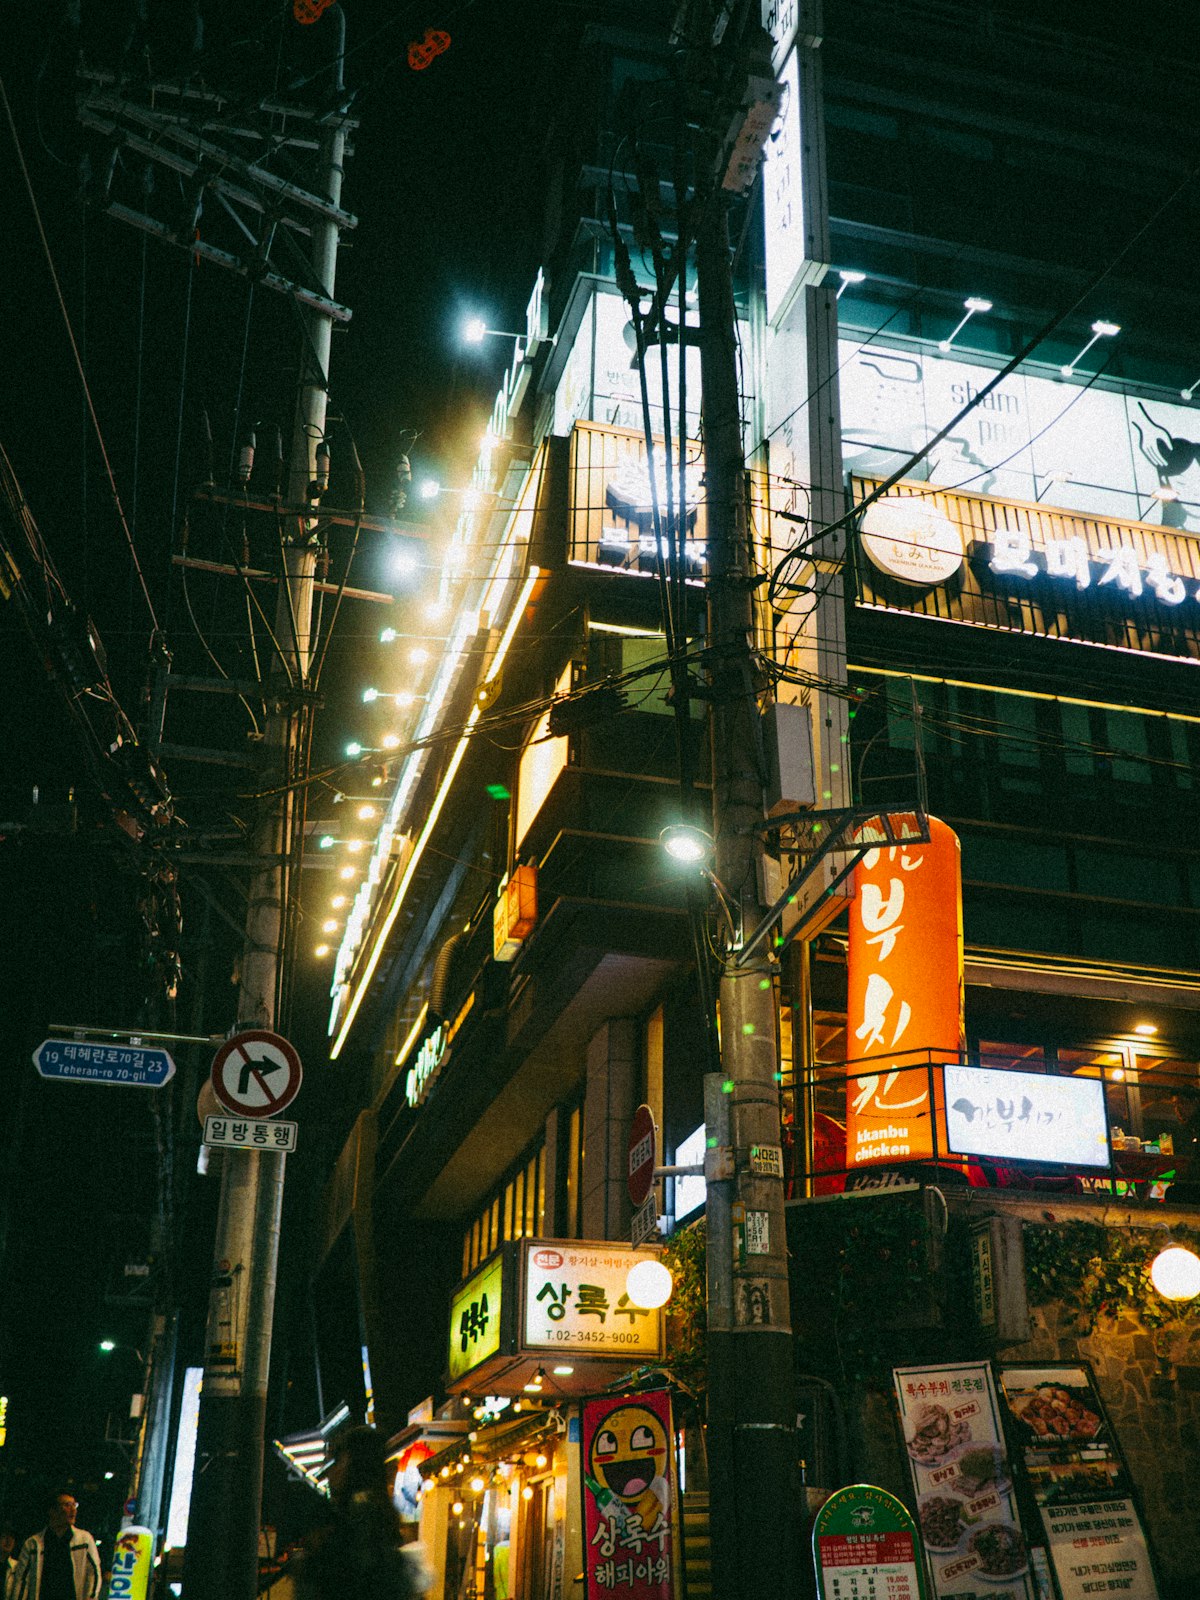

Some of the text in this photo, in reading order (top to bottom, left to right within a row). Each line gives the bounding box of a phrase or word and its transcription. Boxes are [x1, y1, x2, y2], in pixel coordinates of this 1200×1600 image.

[45, 1050, 60, 1064] 19
[64, 1045, 145, 1069] 테헤란로70길
[148, 1060, 163, 1073] 23
[59, 1063, 146, 1082] Teheran-ro 70-gil
[211, 1119, 292, 1146] 일방통행
[857, 1125, 909, 1145] kkanbu
[855, 1142, 911, 1163] chicken
[536, 1253, 561, 1267] 전문
[535, 1281, 651, 1325] 상록수
[545, 1329, 641, 1344] T.02-3452-9002
[951, 1377, 984, 1392] 전문점
[591, 1512, 671, 1557] 상록수
[595, 1553, 671, 1590] 해피아워
